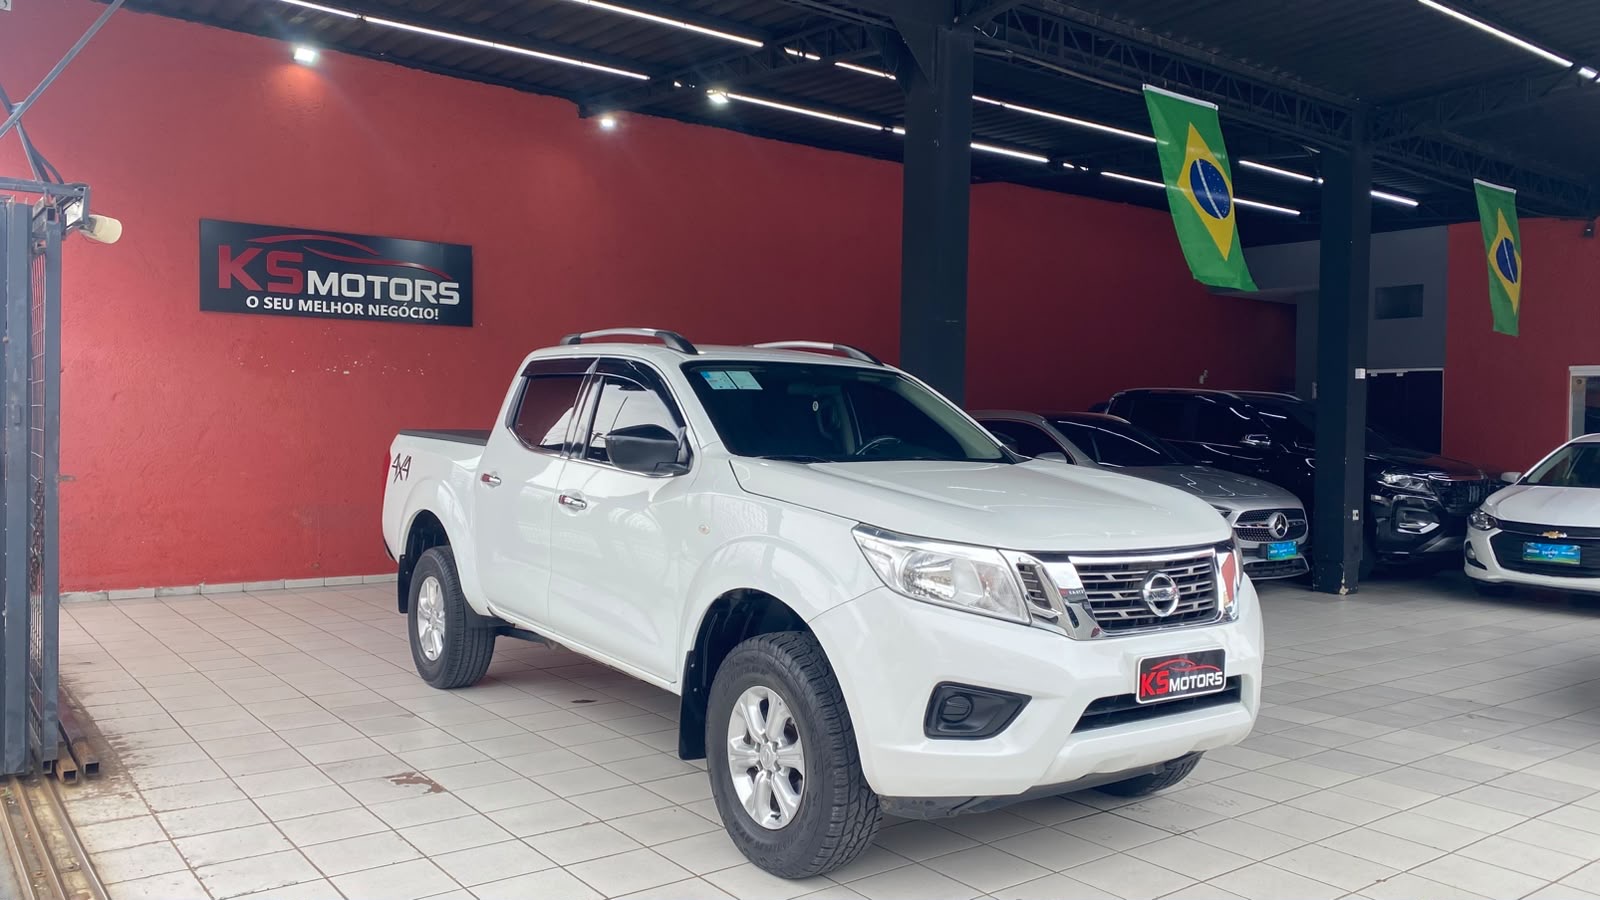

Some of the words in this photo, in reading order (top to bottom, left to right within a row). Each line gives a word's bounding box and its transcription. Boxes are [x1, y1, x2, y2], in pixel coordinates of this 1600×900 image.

[307, 270, 460, 305] MOTORS
[246, 295, 259, 308] O
[263, 296, 293, 310] SEU
[298, 300, 364, 315] MELHOR
[368, 302, 439, 320] NEGÓCIO!
[1169, 671, 1223, 692] MOTORS
